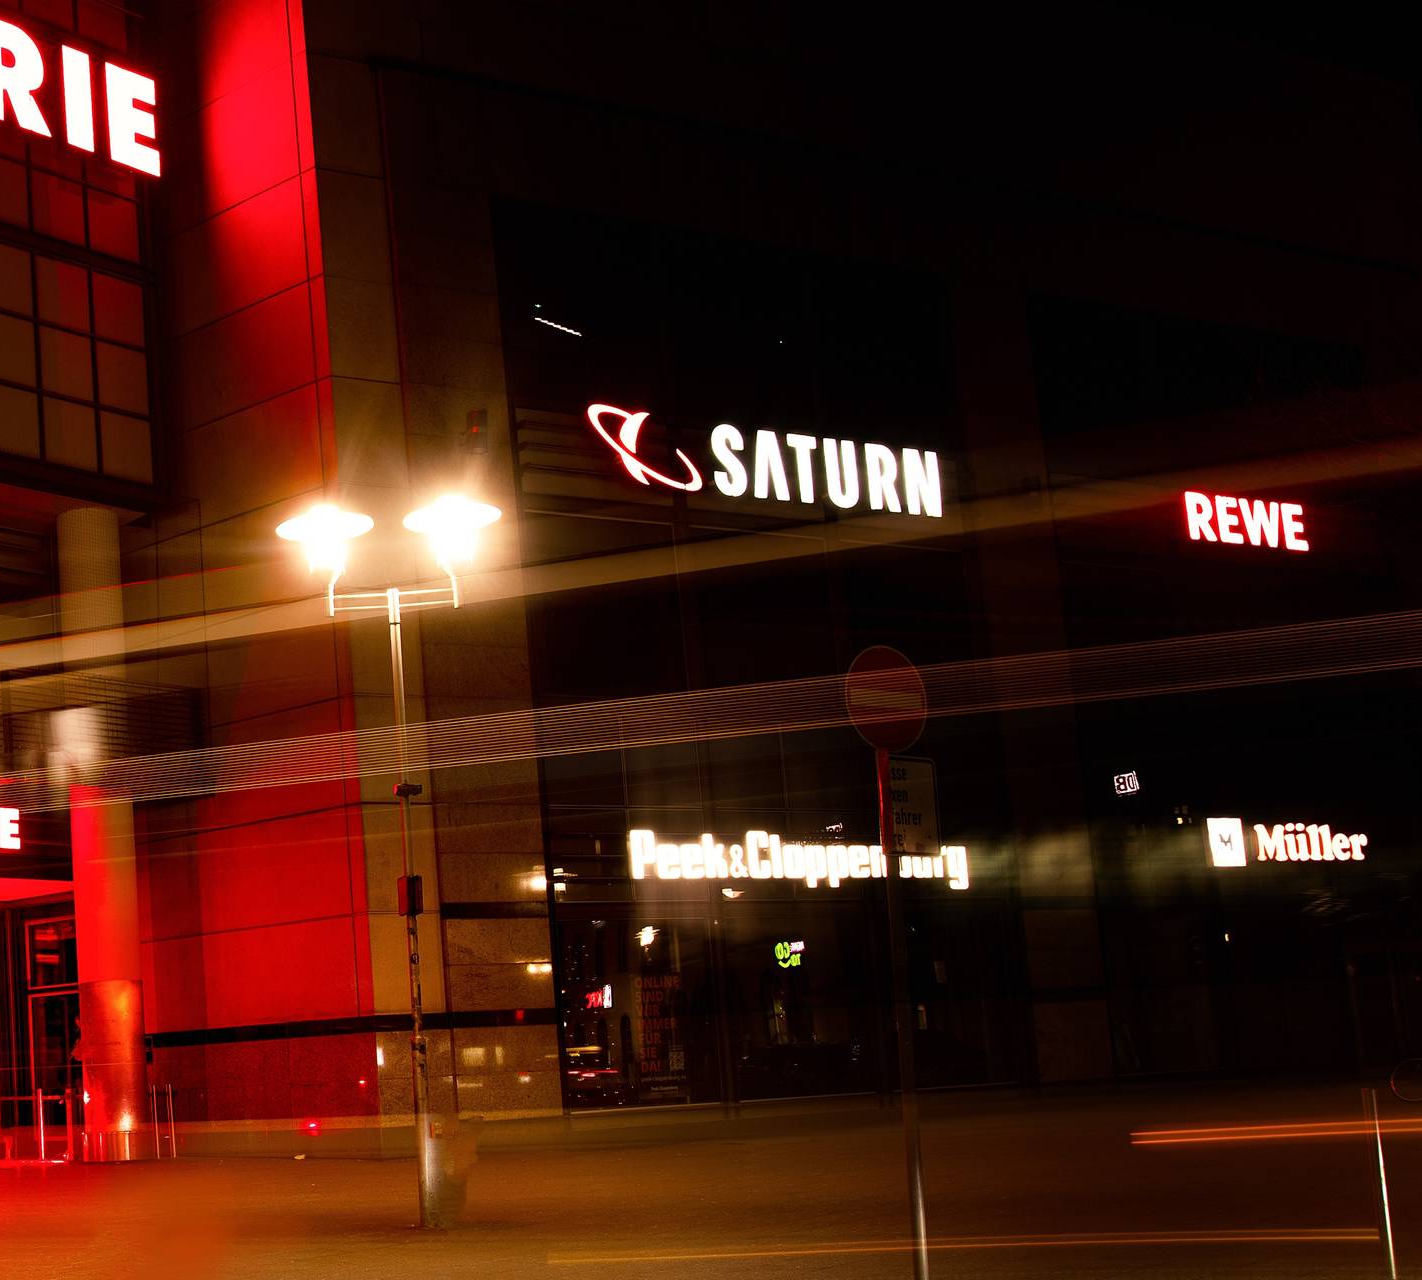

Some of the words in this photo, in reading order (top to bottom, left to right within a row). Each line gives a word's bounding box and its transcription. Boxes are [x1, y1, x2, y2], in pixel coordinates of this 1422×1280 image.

[710, 423, 943, 518] SATURN
[1183, 491, 1310, 552] REWE
[1253, 822, 1368, 862] Müller
[640, 1047, 658, 1059] SIE
